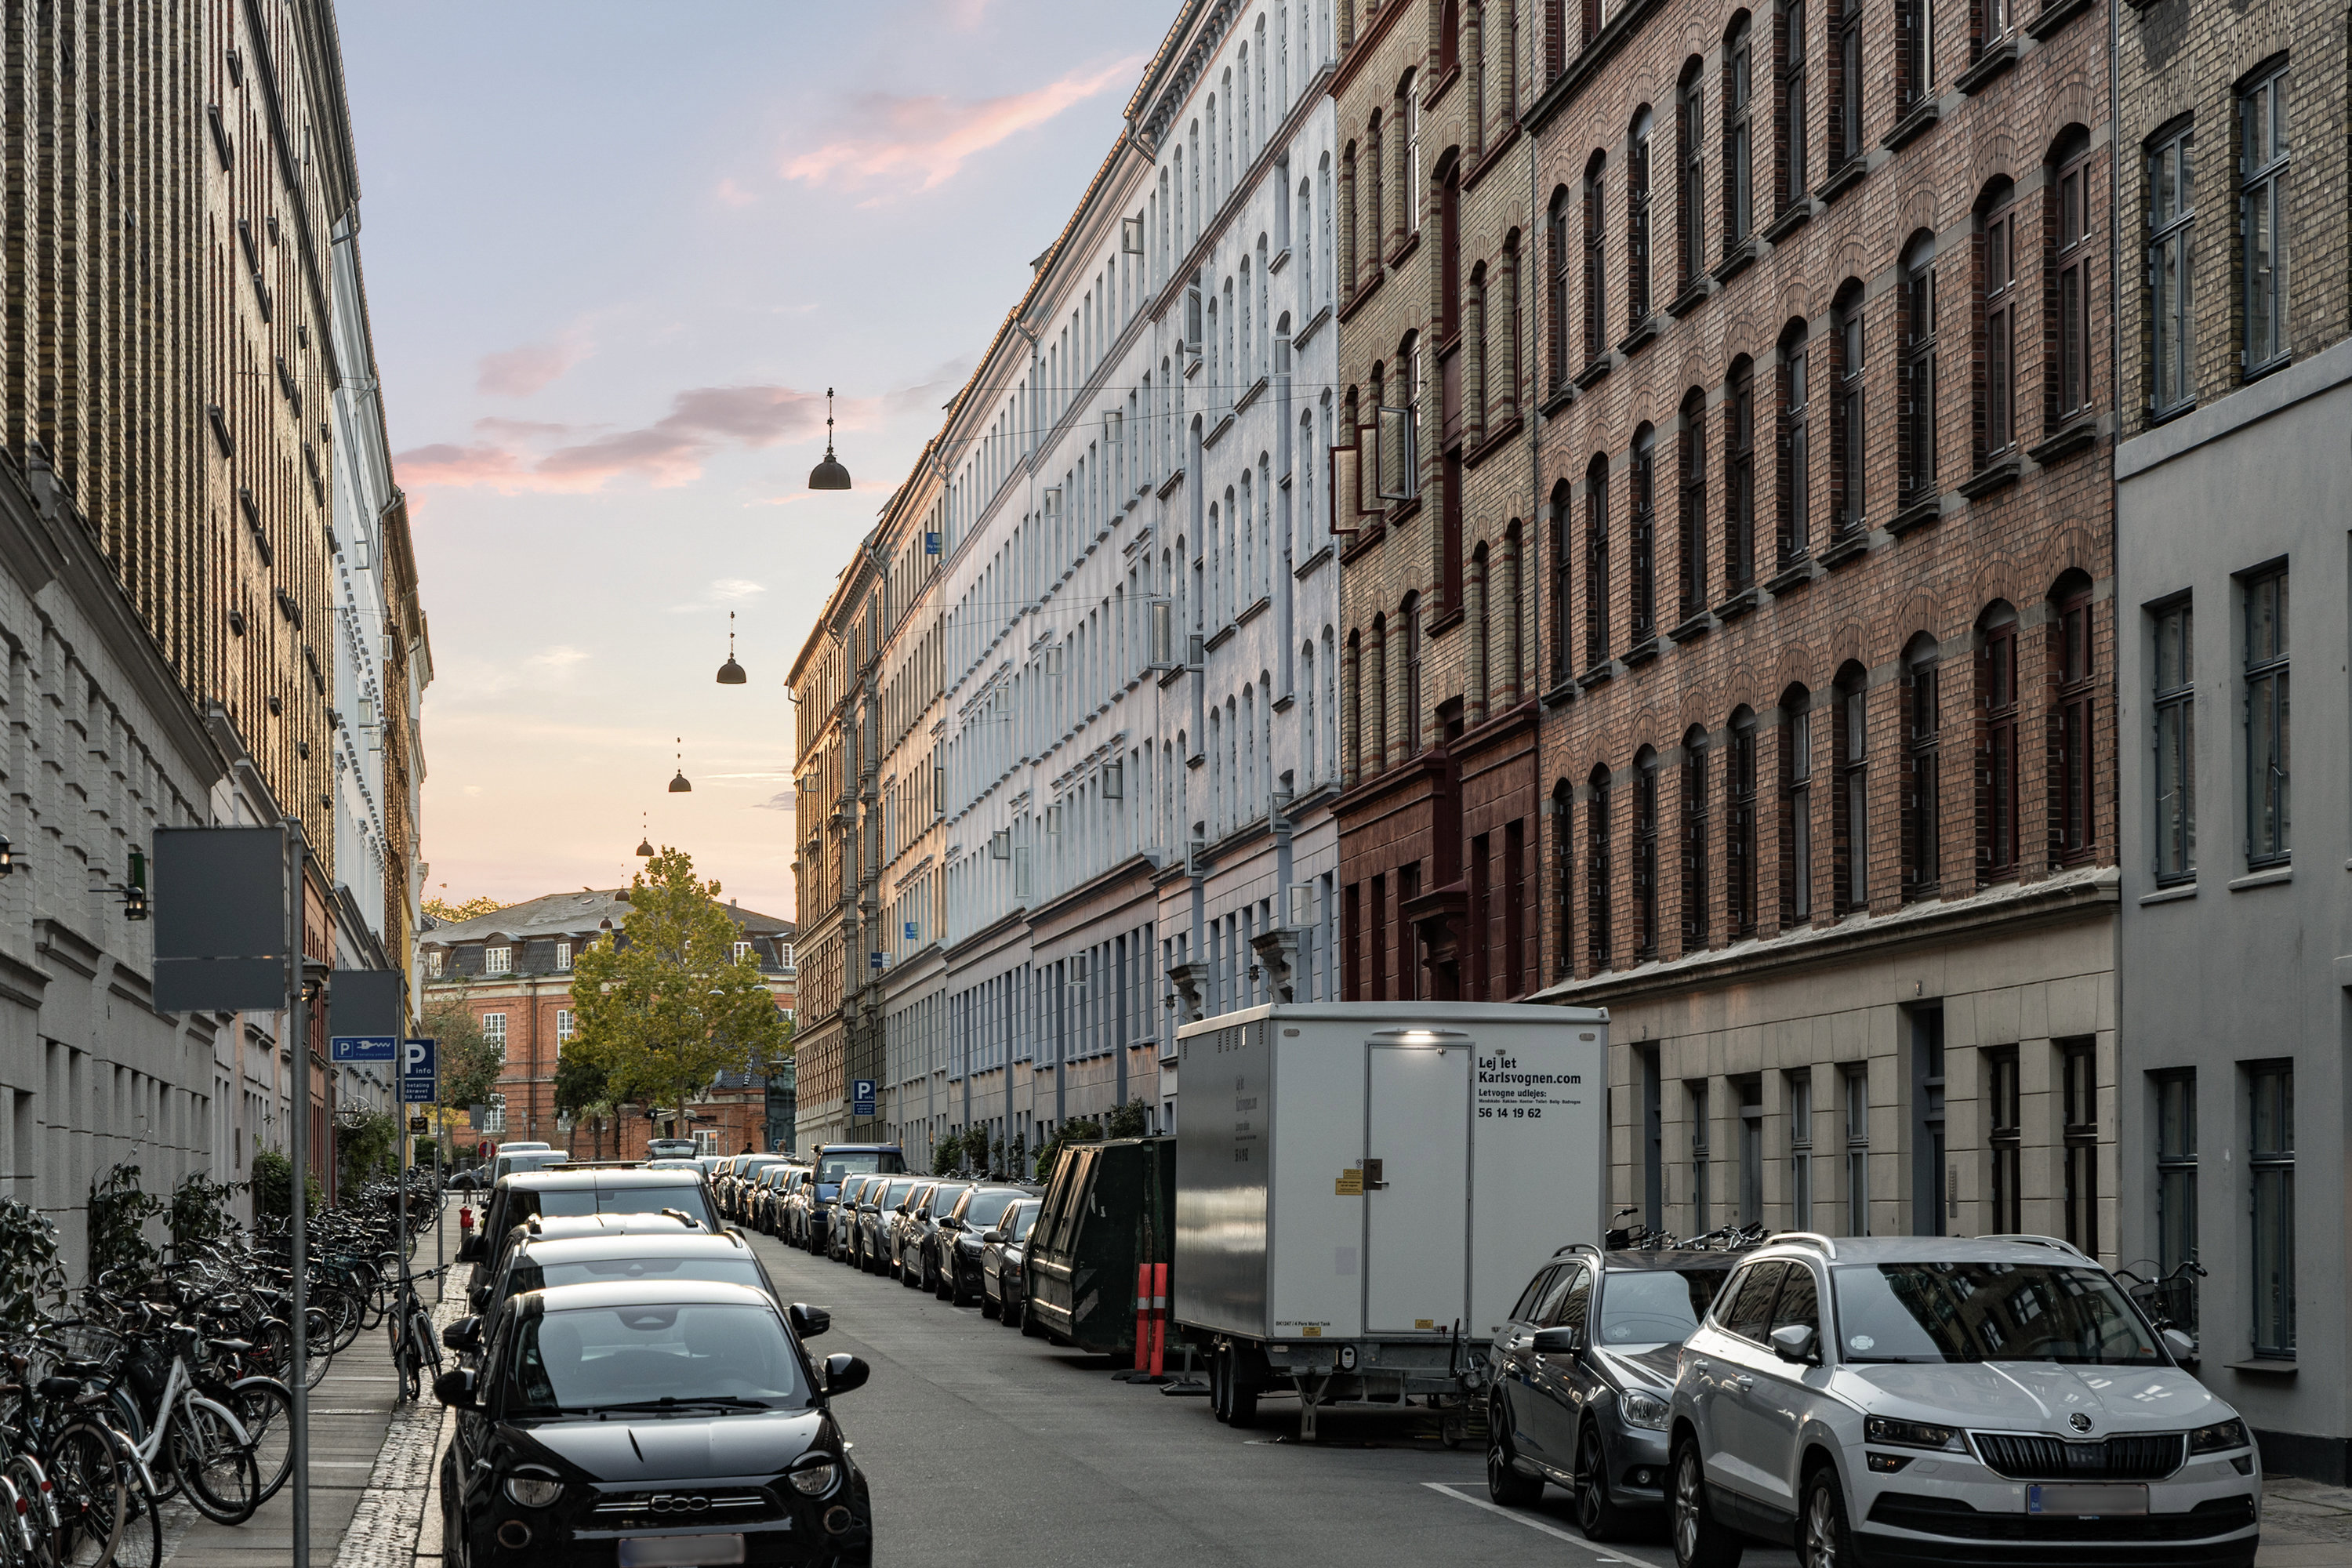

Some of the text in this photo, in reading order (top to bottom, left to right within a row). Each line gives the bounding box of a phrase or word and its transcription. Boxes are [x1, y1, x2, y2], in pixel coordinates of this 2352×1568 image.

[340, 1043, 350, 1055] P
[405, 1044, 426, 1074] P
[1479, 1057, 1516, 1071] Lej let
[1479, 1072, 1581, 1086] Karlsvognen.com
[858, 1083, 870, 1099] P
[1479, 1089, 1547, 1098] Letvogne udlejes:
[1479, 1108, 1541, 1118] 56 14 19 62
[651, 1494, 709, 1512] 500
